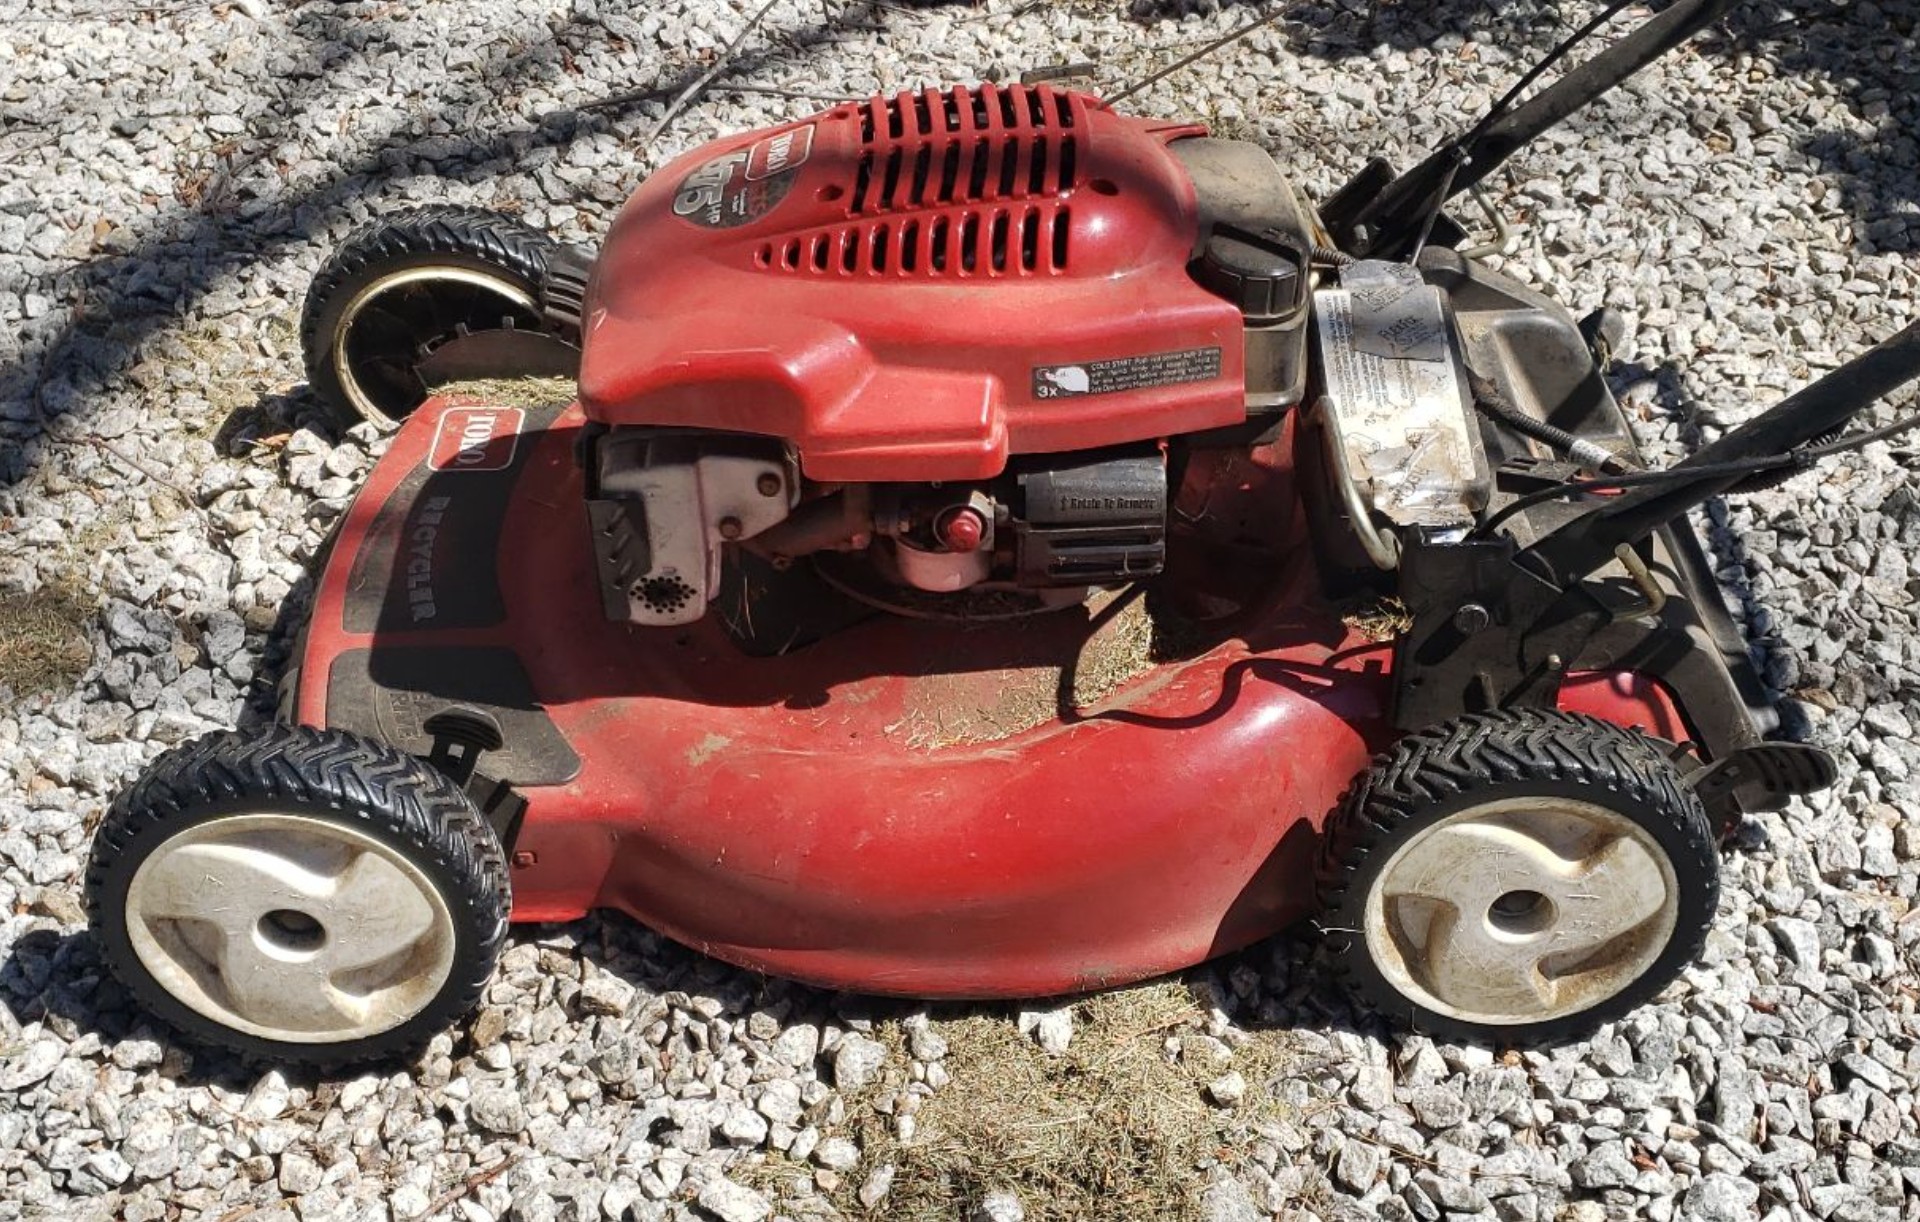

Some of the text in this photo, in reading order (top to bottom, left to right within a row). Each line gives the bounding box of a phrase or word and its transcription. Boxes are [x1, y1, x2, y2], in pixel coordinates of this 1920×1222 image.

[767, 132, 793, 170] TORO
[1112, 359, 1132, 370] START
[1038, 385, 1058, 397] 3x
[457, 414, 496, 464] TORO
[407, 497, 450, 623] RECYCLER
